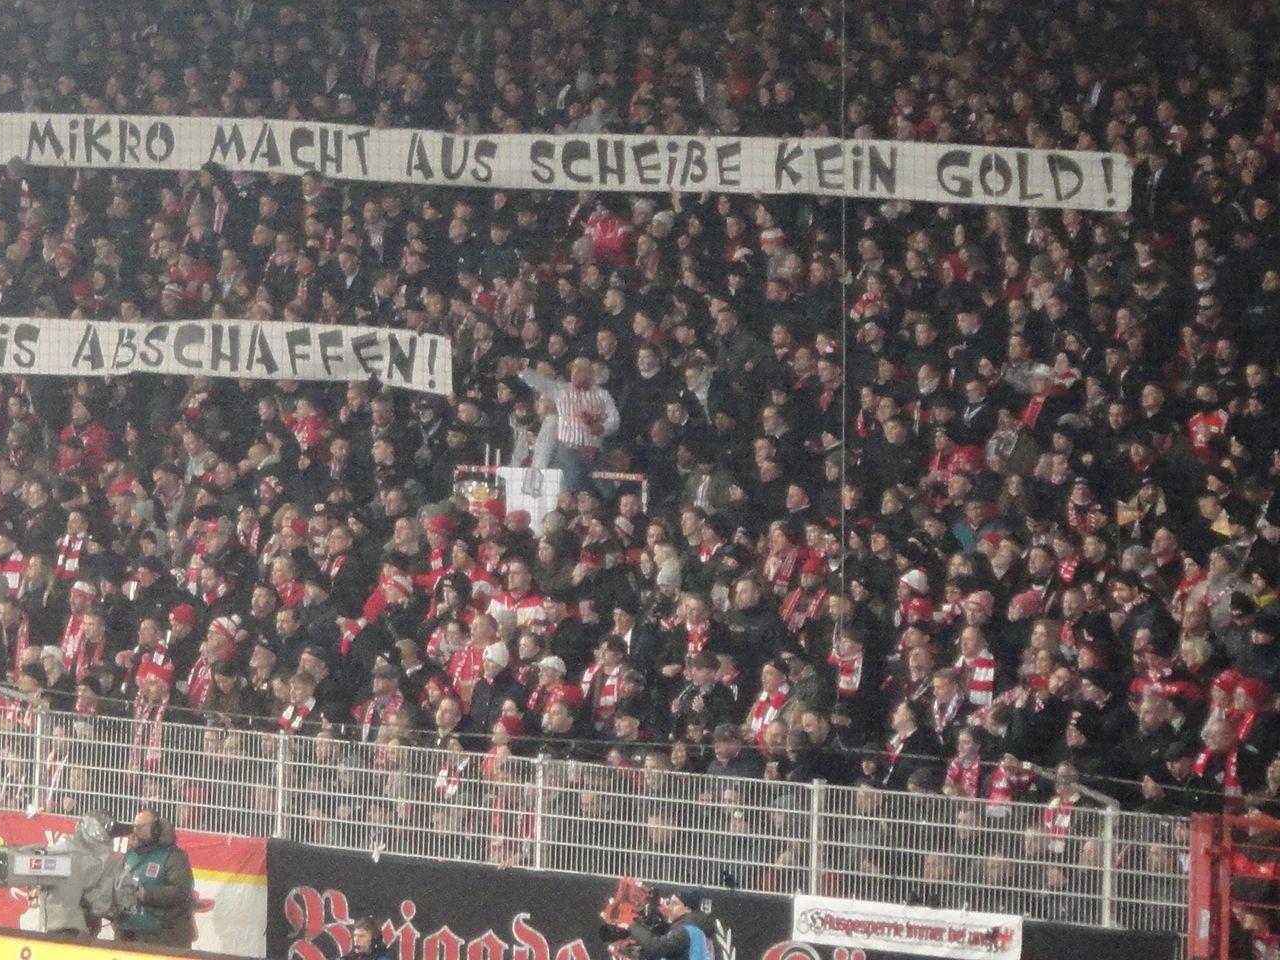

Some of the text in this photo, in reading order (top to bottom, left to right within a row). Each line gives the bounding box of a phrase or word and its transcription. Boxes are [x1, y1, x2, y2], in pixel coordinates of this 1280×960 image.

[209, 123, 371, 177] MACHT
[406, 133, 498, 183] AUS
[936, 150, 1115, 207] GOLD!
[72, 323, 439, 389] ABSCHAFFEN!
